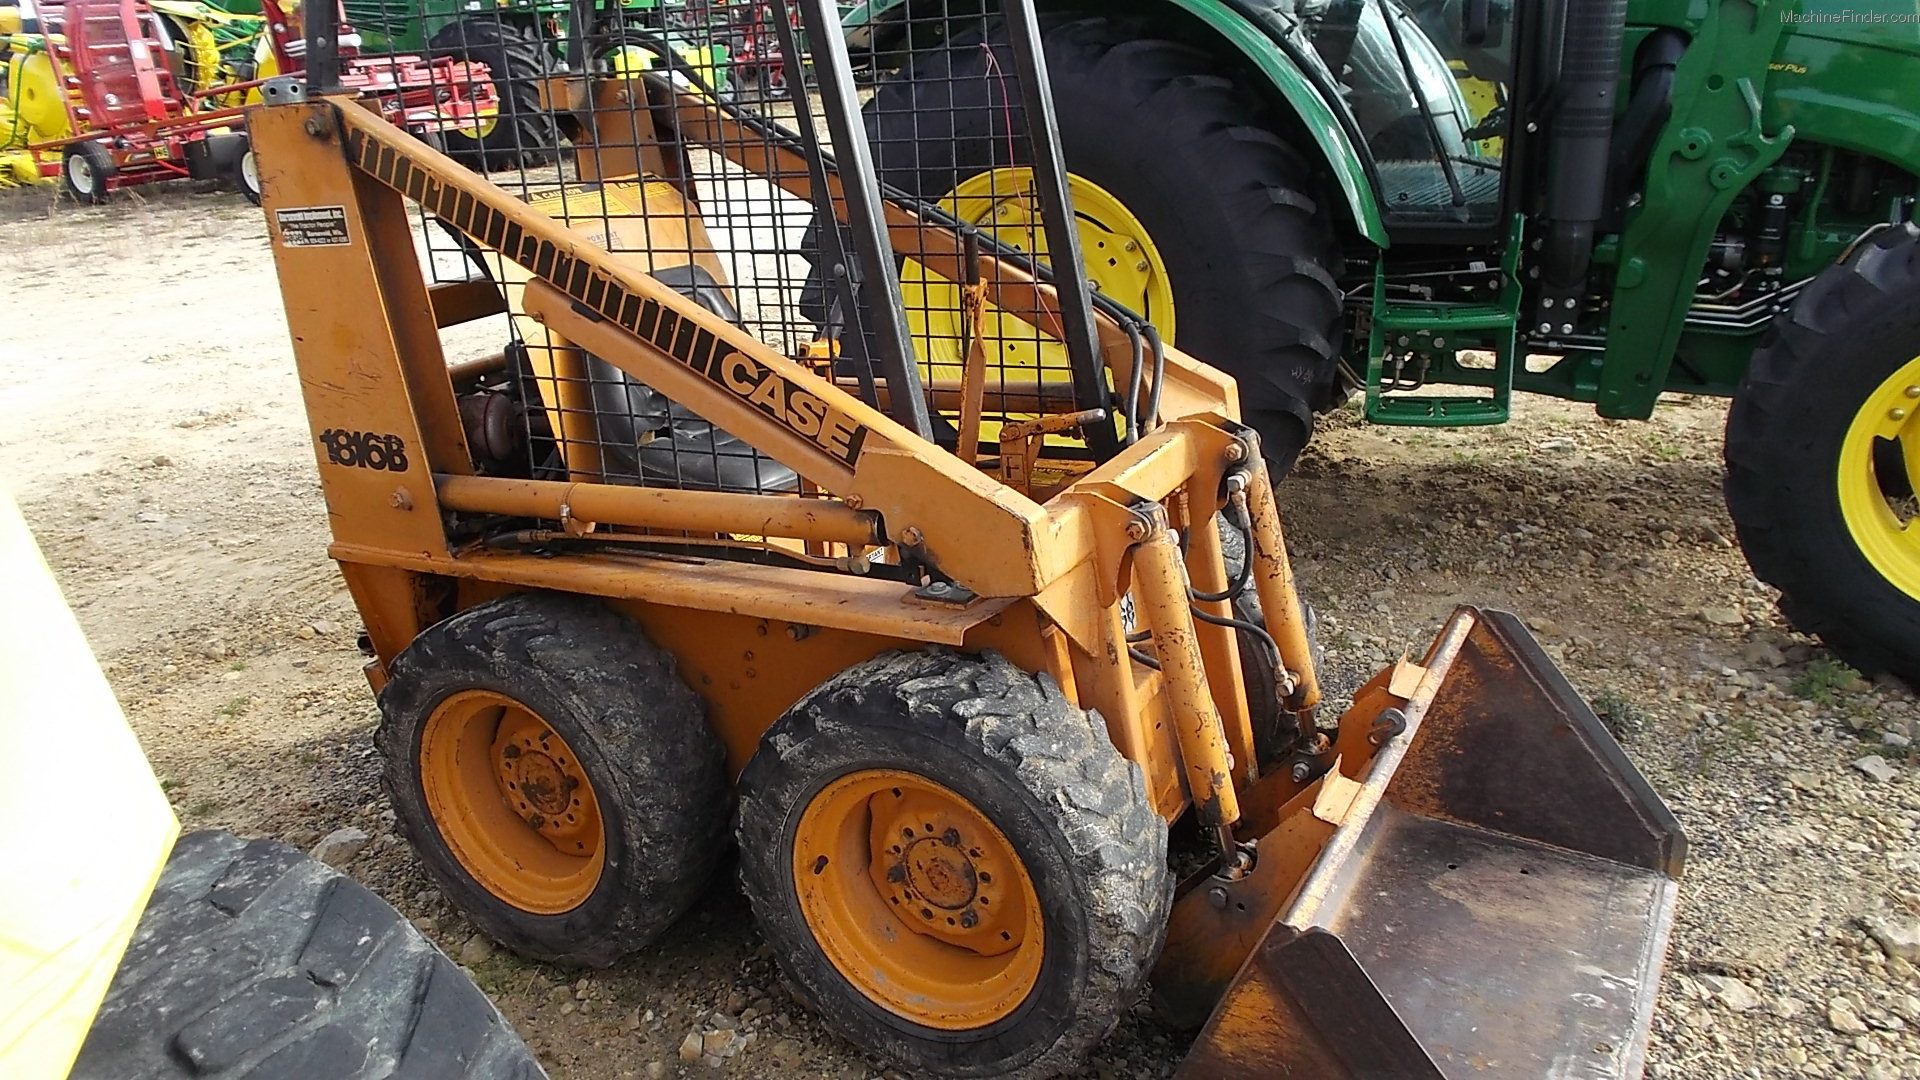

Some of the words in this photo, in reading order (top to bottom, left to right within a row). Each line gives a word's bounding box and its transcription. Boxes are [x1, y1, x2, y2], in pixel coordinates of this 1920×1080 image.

[1785, 63, 1808, 74] Plus
[541, 188, 582, 199] CAUION
[721, 350, 861, 459] CASE
[319, 428, 409, 473] 1816B
